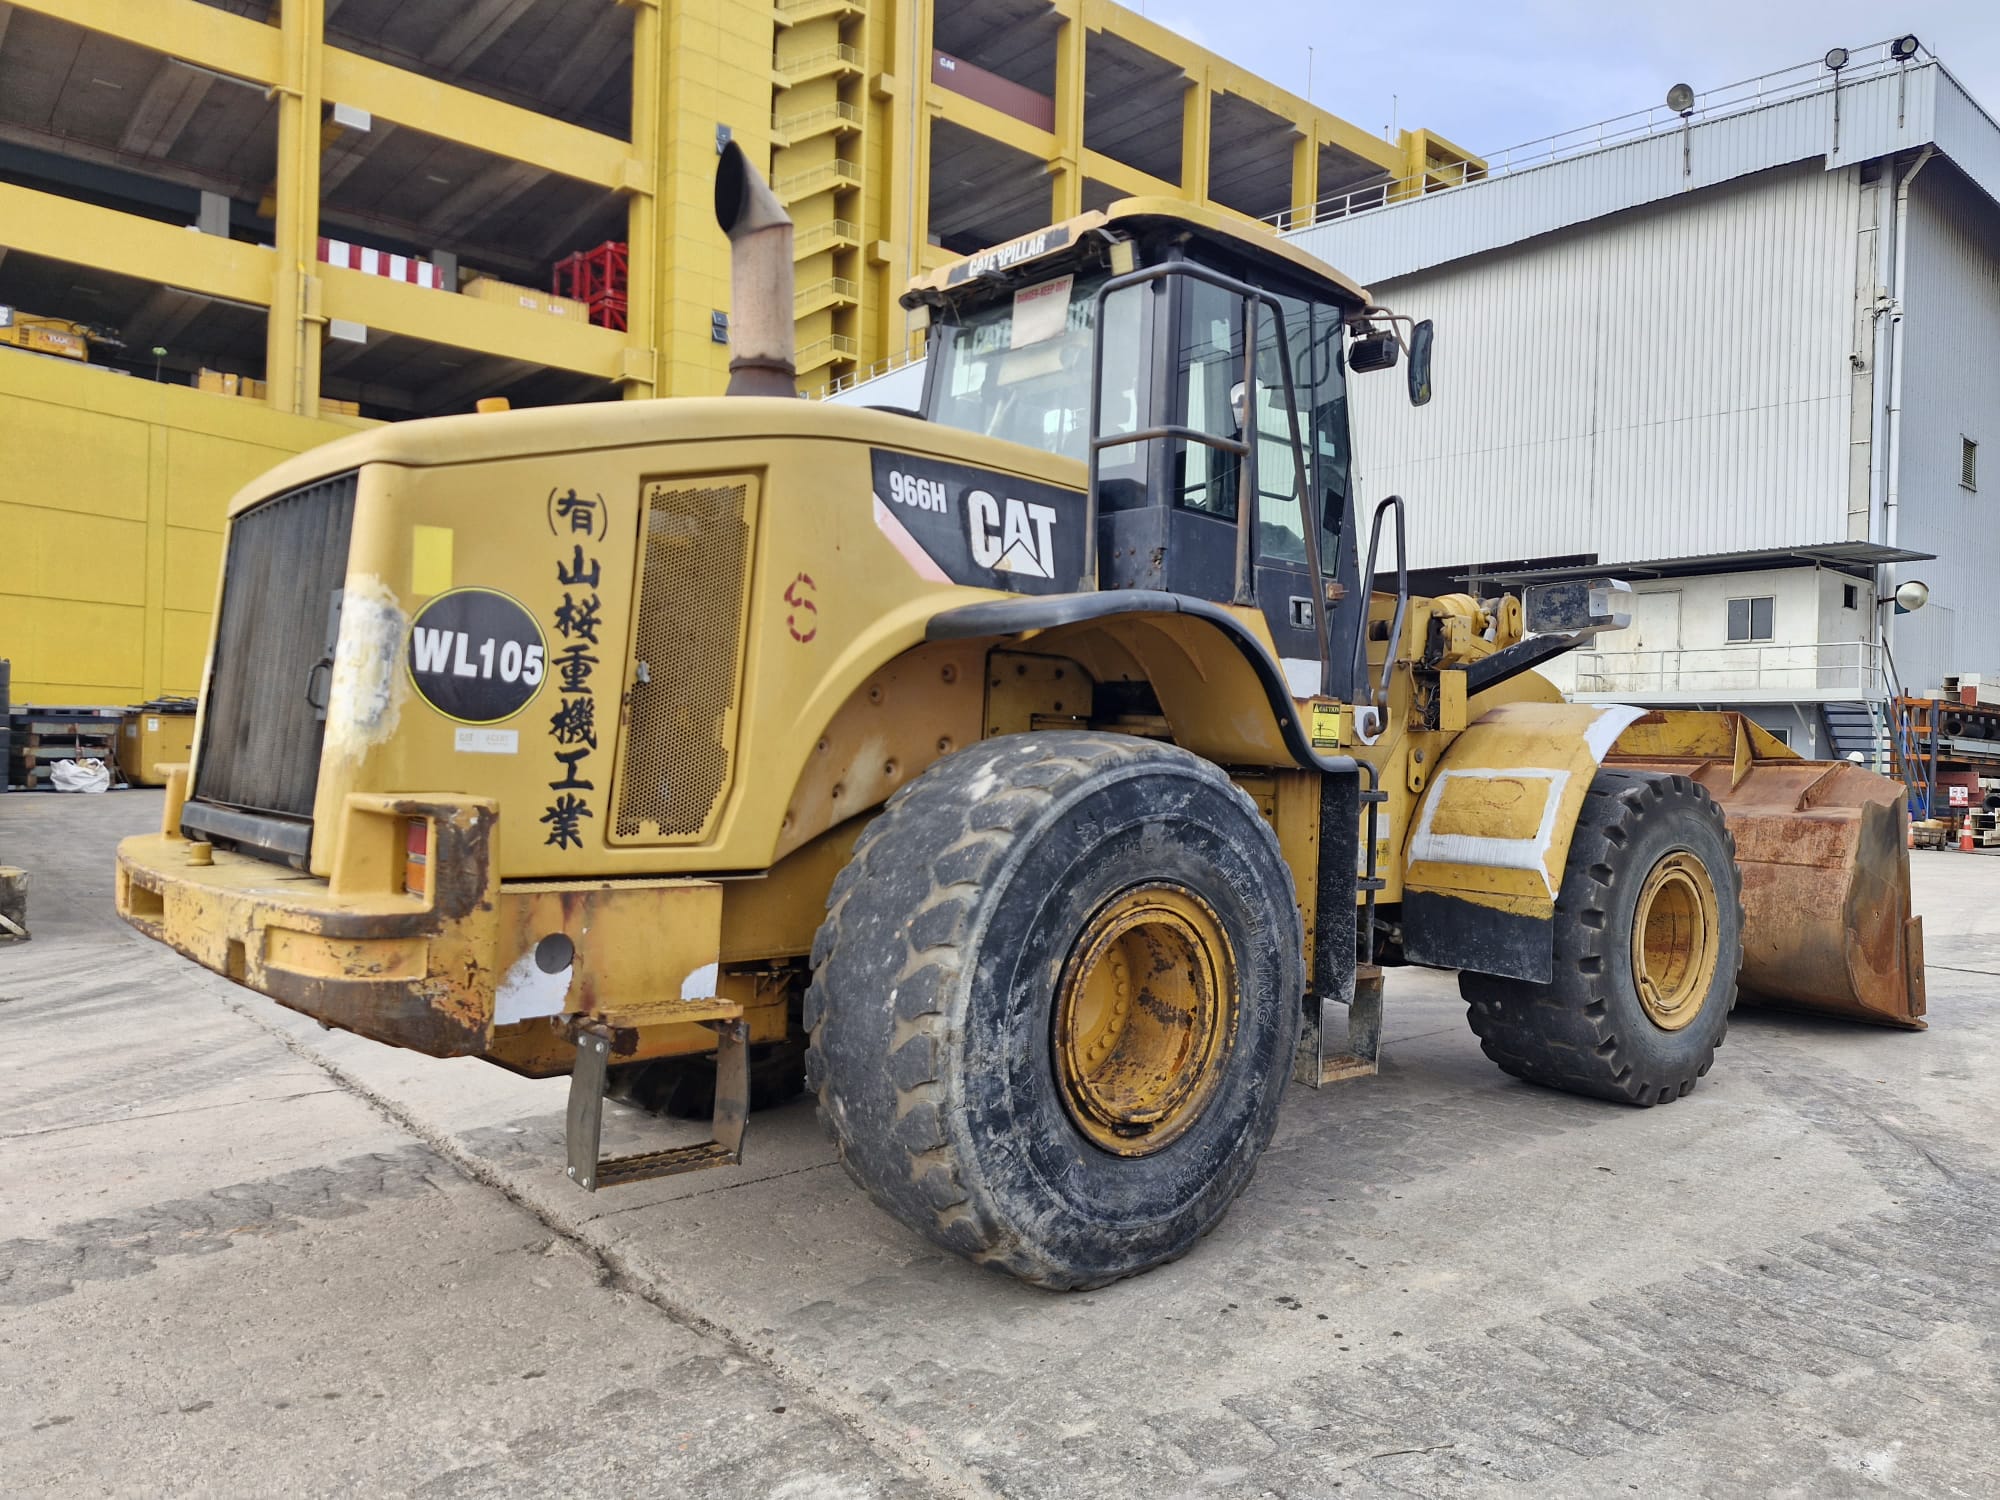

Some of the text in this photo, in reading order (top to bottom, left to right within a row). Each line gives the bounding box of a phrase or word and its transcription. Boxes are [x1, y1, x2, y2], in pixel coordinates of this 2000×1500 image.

[968, 233, 1047, 278] CATERPILLAR
[889, 470, 948, 514] 966H
[967, 489, 1057, 579] CAT
[413, 626, 545, 686] WL105
